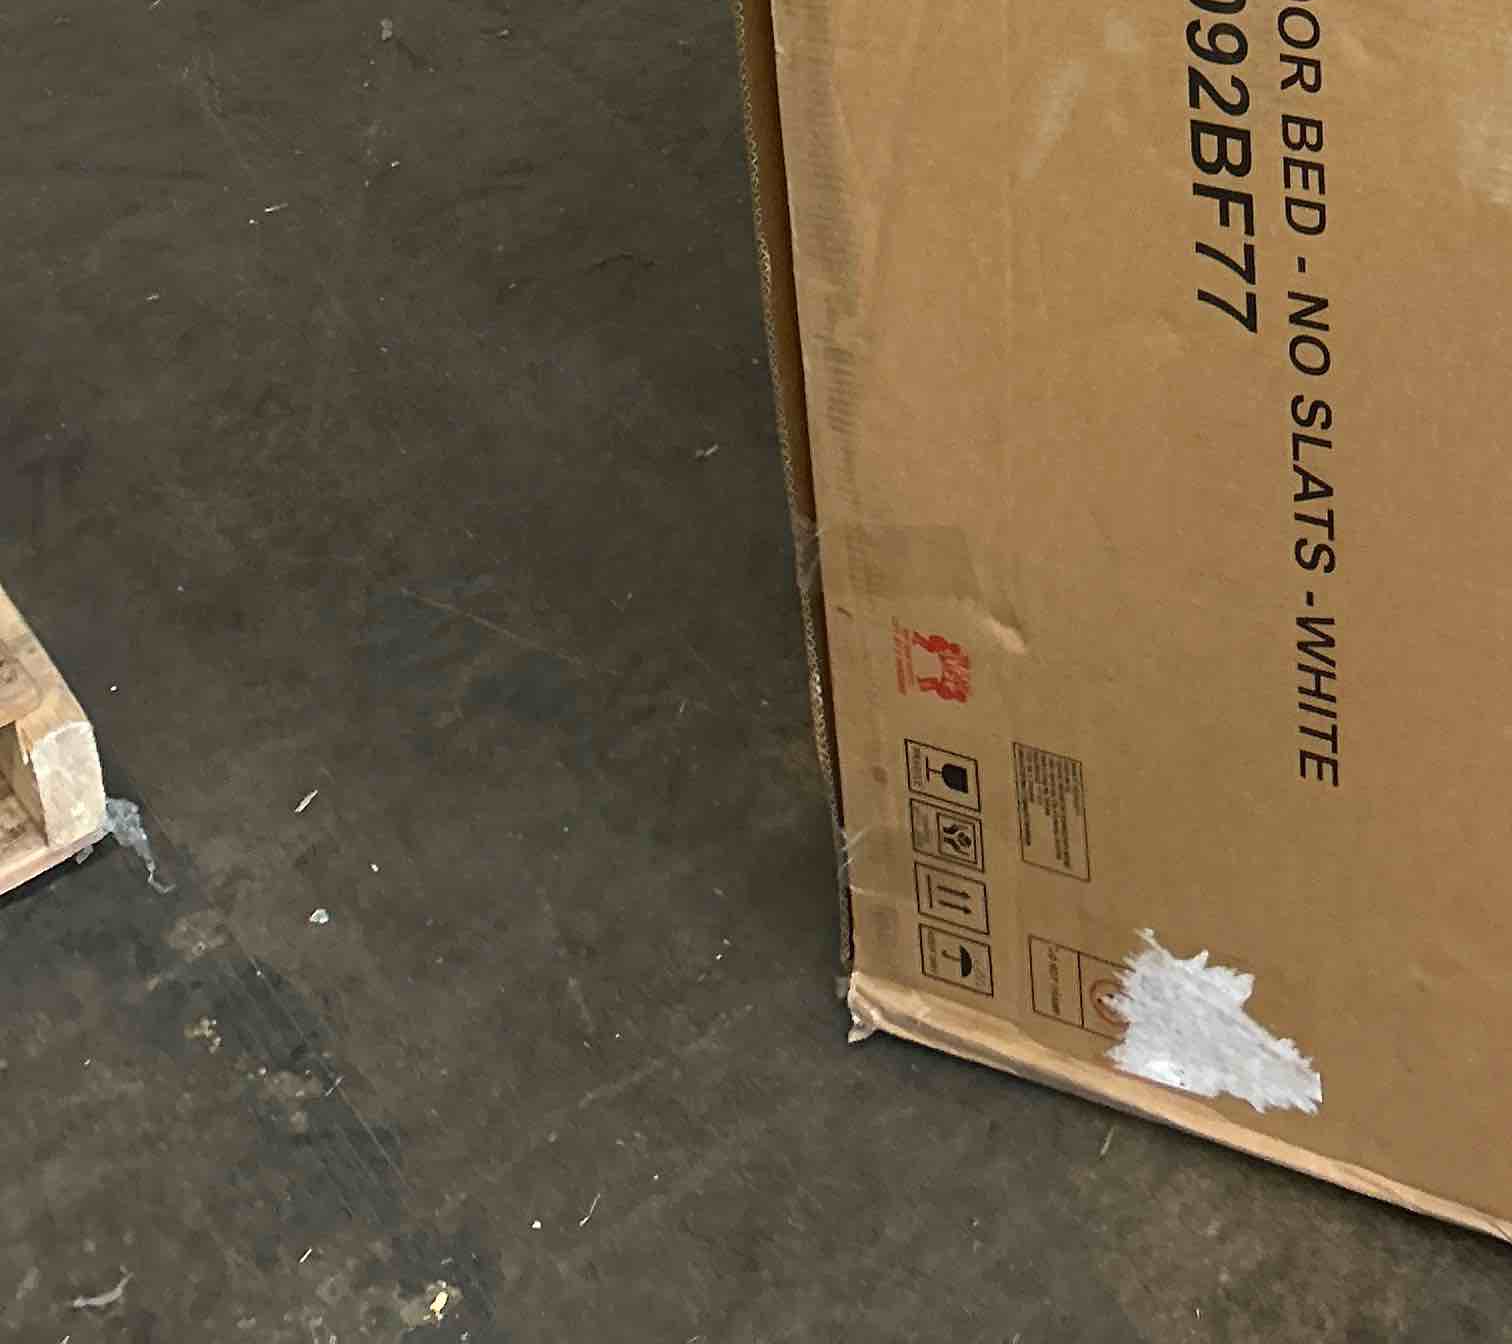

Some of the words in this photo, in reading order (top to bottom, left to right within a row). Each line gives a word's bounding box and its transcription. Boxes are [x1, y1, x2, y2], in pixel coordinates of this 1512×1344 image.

[1281, 112, 1327, 236] BED
[1289, 292, 1334, 376] NO
[1292, 393, 1338, 574] SLATS
